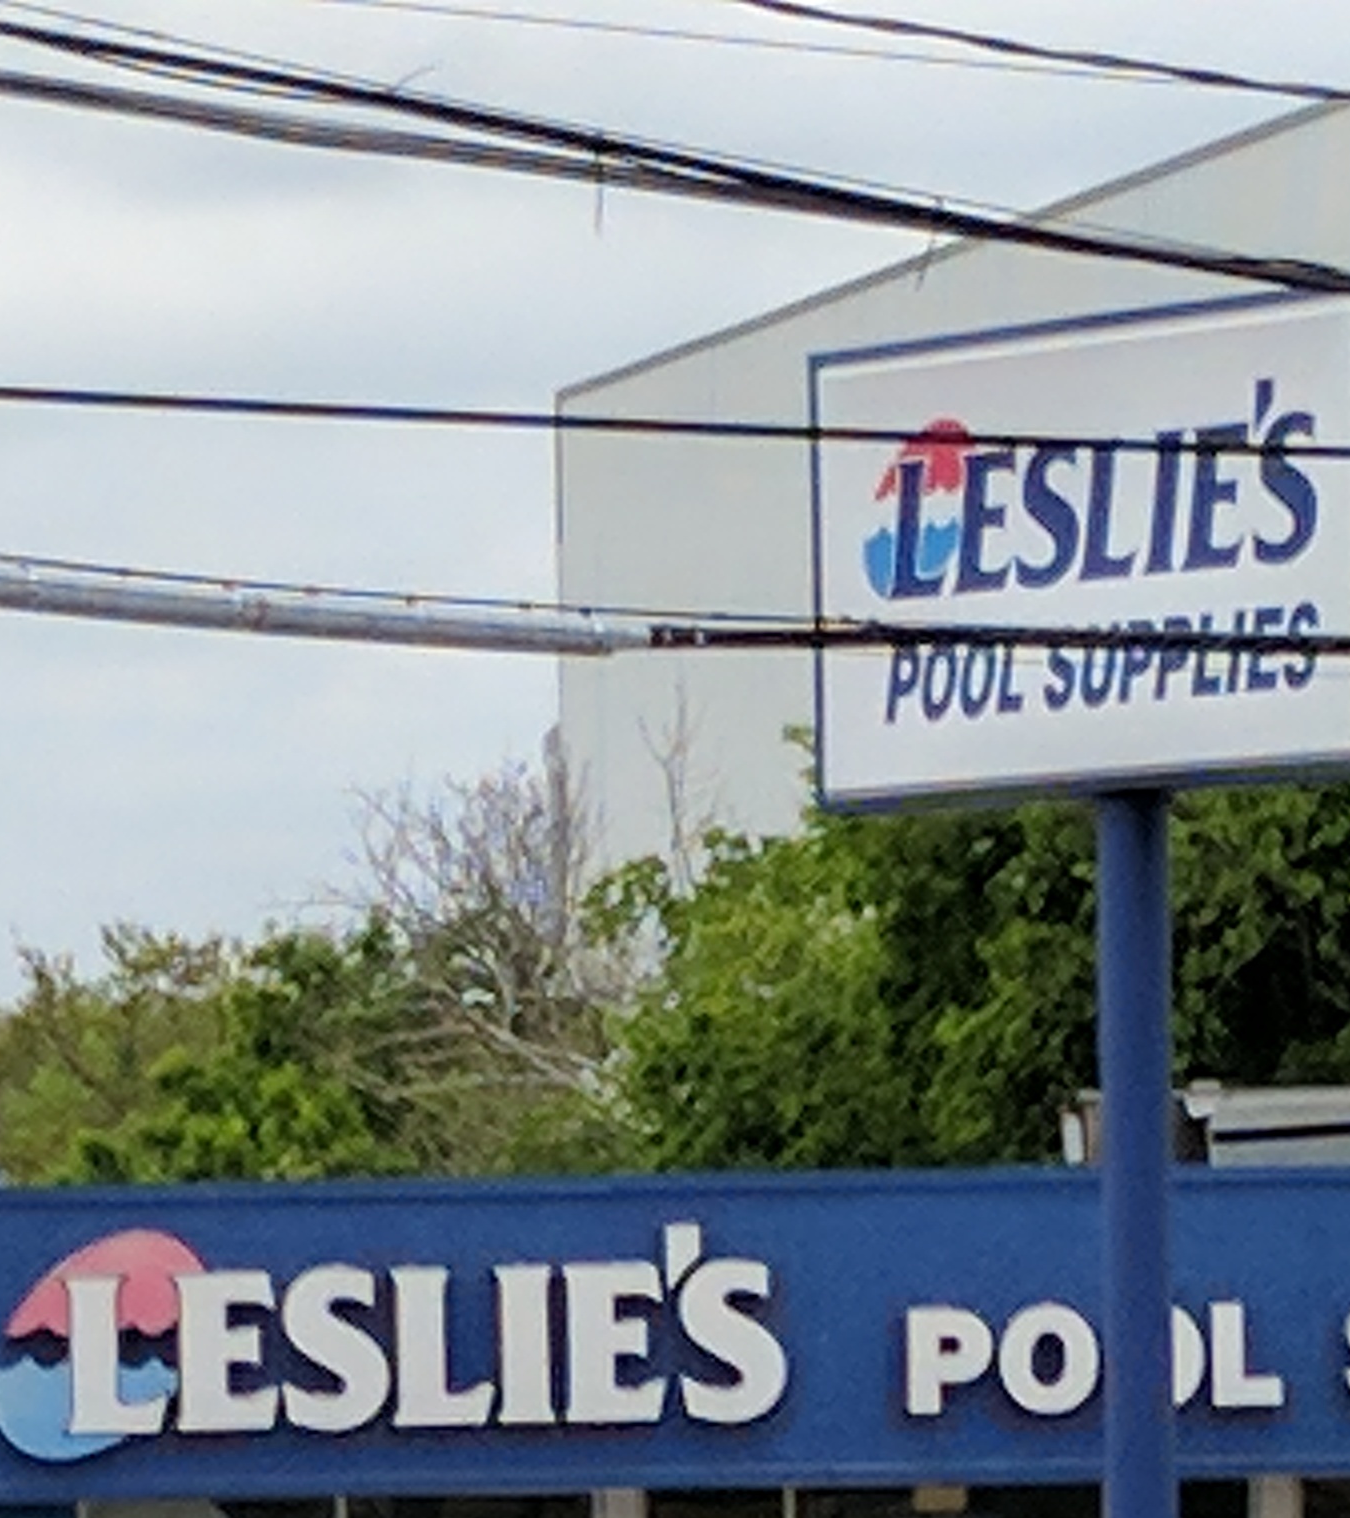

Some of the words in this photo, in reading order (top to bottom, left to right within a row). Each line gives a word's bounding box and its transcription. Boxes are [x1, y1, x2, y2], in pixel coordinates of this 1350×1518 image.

[889, 377, 1319, 600] LESLIE'S
[884, 634, 1024, 725] POOL
[1043, 602, 1321, 711] SUPPLIES
[65, 1222, 788, 1435] LESLIE'S
